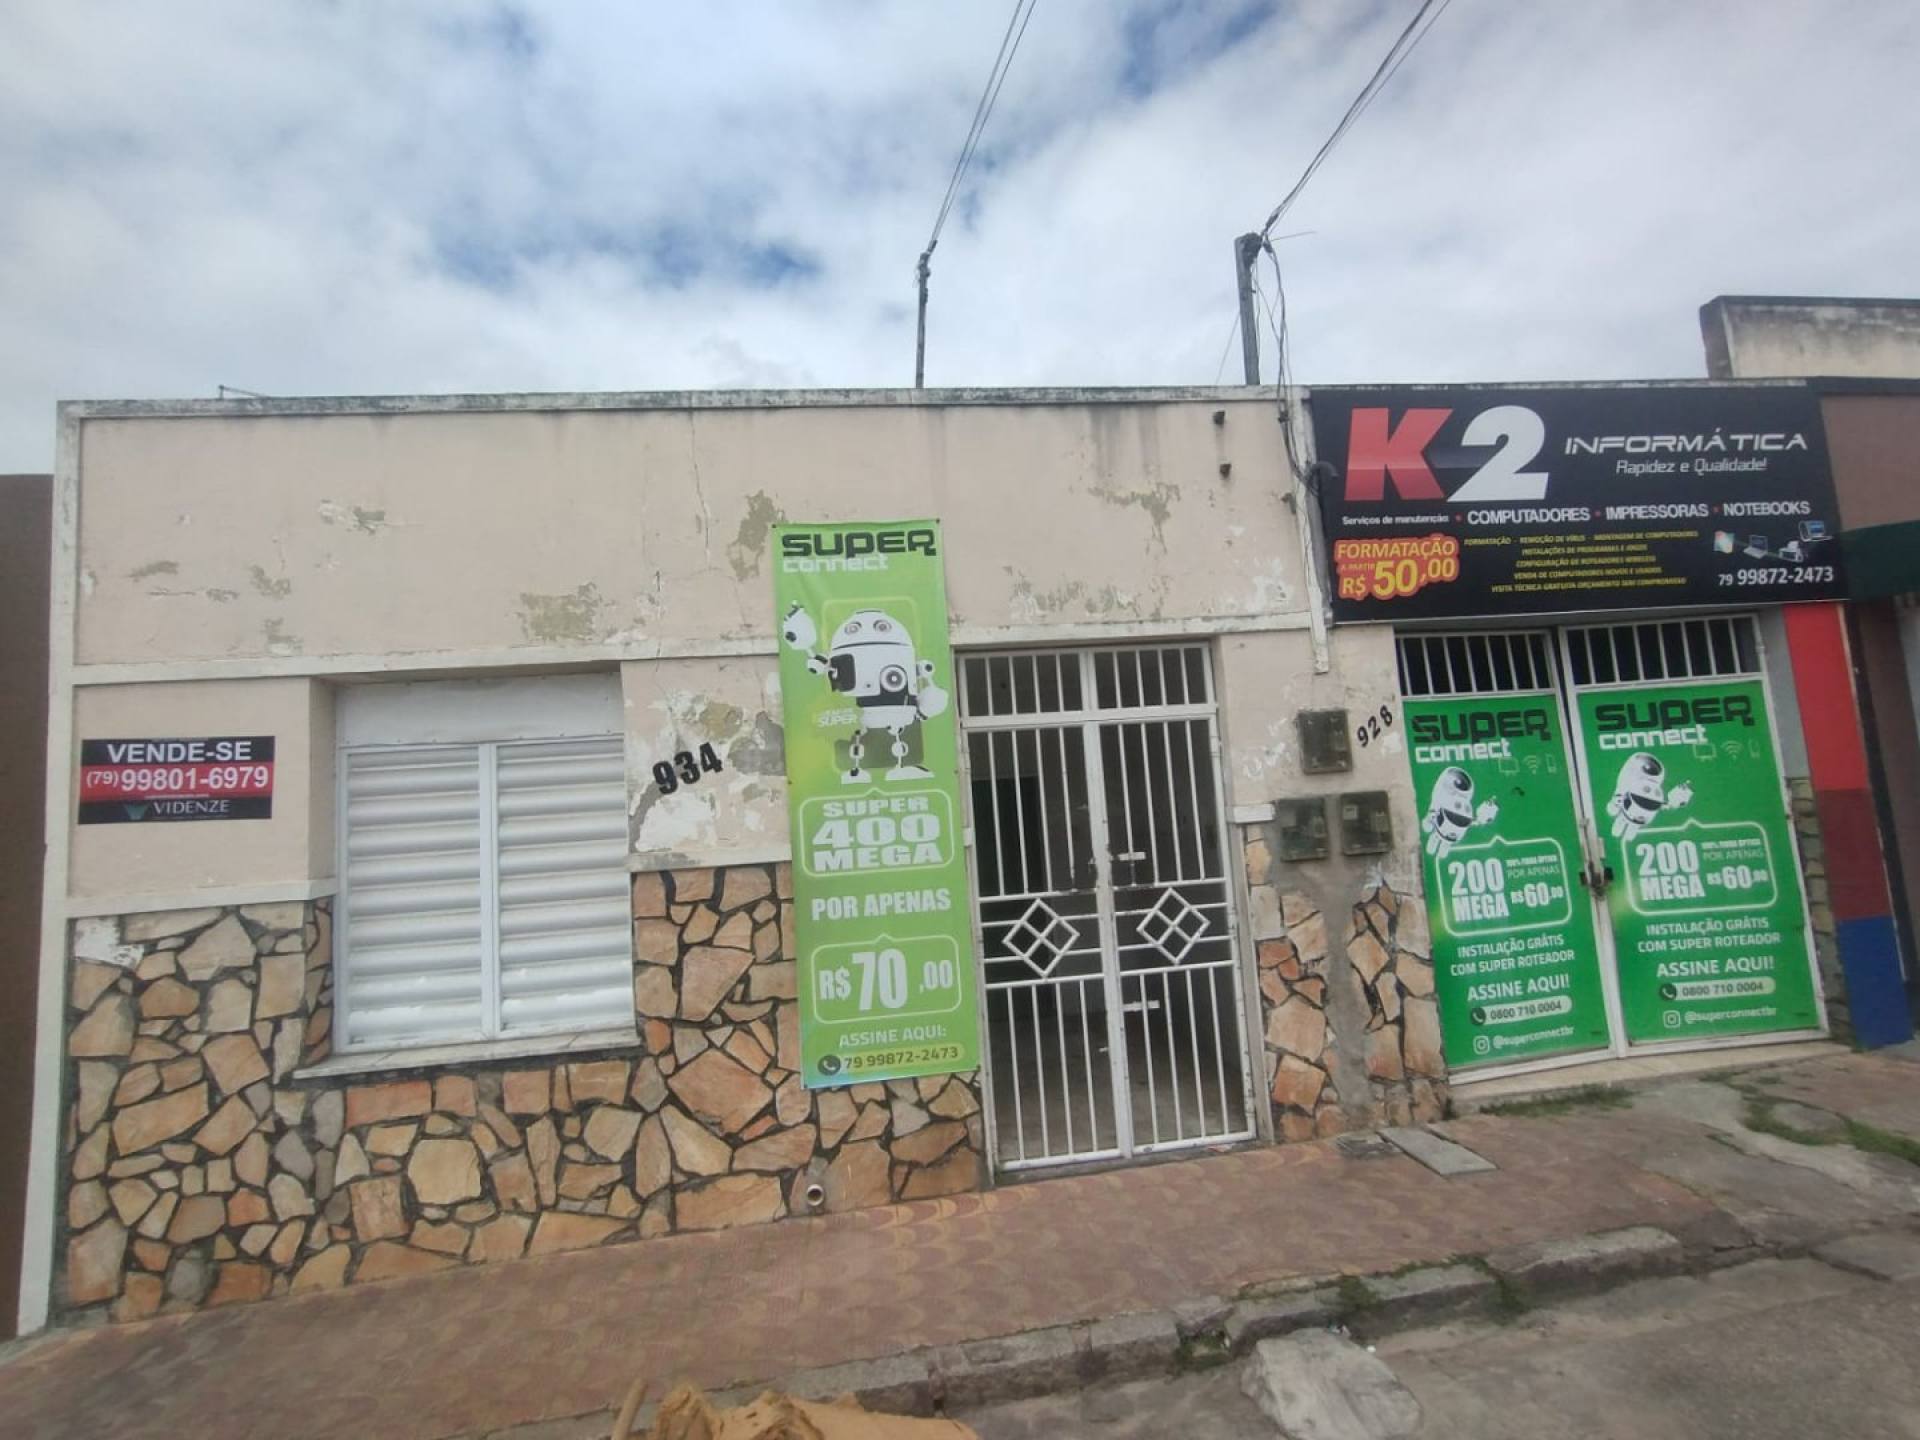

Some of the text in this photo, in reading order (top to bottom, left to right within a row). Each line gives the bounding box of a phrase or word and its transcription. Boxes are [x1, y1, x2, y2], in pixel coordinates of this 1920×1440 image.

[1564, 427, 1808, 455] INFORMÁTICA
[1344, 405, 1549, 503] K2
[1616, 457, 1768, 477] Rapidez e Qualidade!
[1342, 501, 1811, 525] Serviços de manutenção COMPUTADORES IMPRESSORAS NOTEBOOKS
[782, 529, 937, 559] SUPER
[1338, 537, 1456, 559] FORMATAÇÃO
[782, 553, 890, 573] connect
[1343, 574, 1366, 596] R$
[1718, 566, 1834, 586] 79 99872-2473
[1596, 695, 1755, 731] SUPER
[1357, 705, 1393, 748] 928
[1412, 709, 1552, 743] SUPER
[1600, 724, 1708, 750] connect
[107, 741, 252, 764] VENDE-SE
[1415, 737, 1512, 764] connect
[86, 766, 269, 791] (79) 99801-6979
[652, 742, 724, 794] 934
[153, 800, 231, 814] VIDENZE
[823, 796, 928, 817] SUPER
[812, 813, 940, 848] 400
[814, 843, 943, 872] MEGA
[1636, 840, 1699, 876] 200
[1448, 858, 1504, 896] 200
[1639, 872, 1706, 900] MEGA
[812, 888, 952, 921] POR APENAS
[1452, 892, 1509, 922] MEGA
[1646, 915, 1769, 936] INSTALAÇÃO GRÁTIS
[1457, 933, 1564, 958] INSTALAÇÃO GRÁTIS
[1638, 932, 1781, 952] COM SUPER ROTEADOR
[1451, 949, 1575, 977] COM SUPER ROTEADOR
[1656, 956, 1774, 978] ASSINE AQUI!
[1467, 973, 1570, 1002] ASSINE AQUI!
[1682, 982, 1764, 997] 0800 710 0004
[1490, 1001, 1562, 1020] 0800 710 0004
[839, 1027, 898, 1048] ASSINE
[844, 1047, 958, 1069] 79 99872-2473
